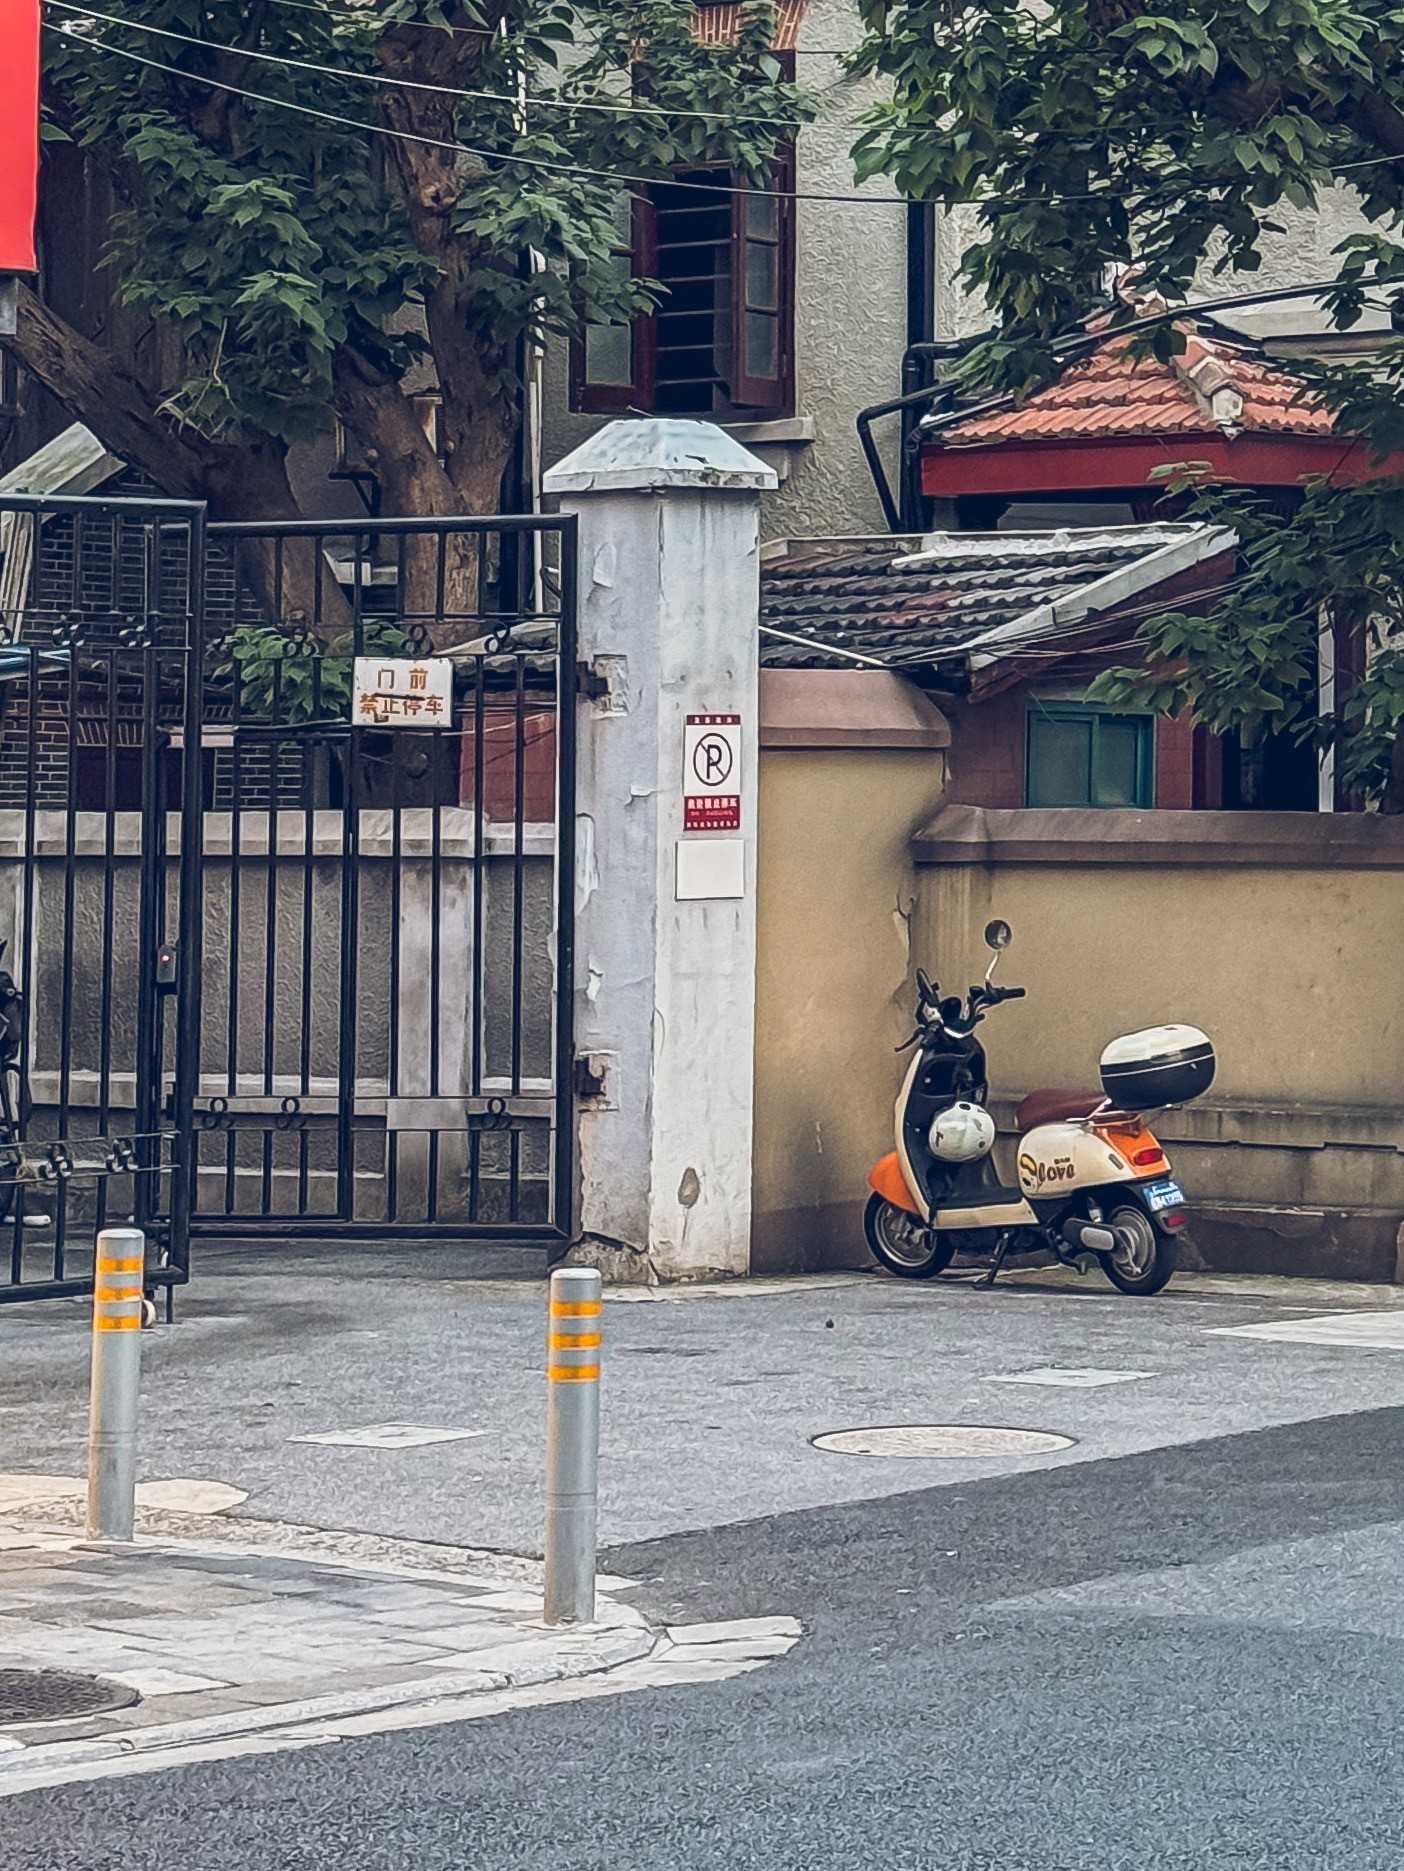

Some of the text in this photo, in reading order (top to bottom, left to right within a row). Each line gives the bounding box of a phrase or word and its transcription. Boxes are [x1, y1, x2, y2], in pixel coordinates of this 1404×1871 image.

[378, 668, 428, 689] 门前
[360, 693, 443, 716] 禁止停车
